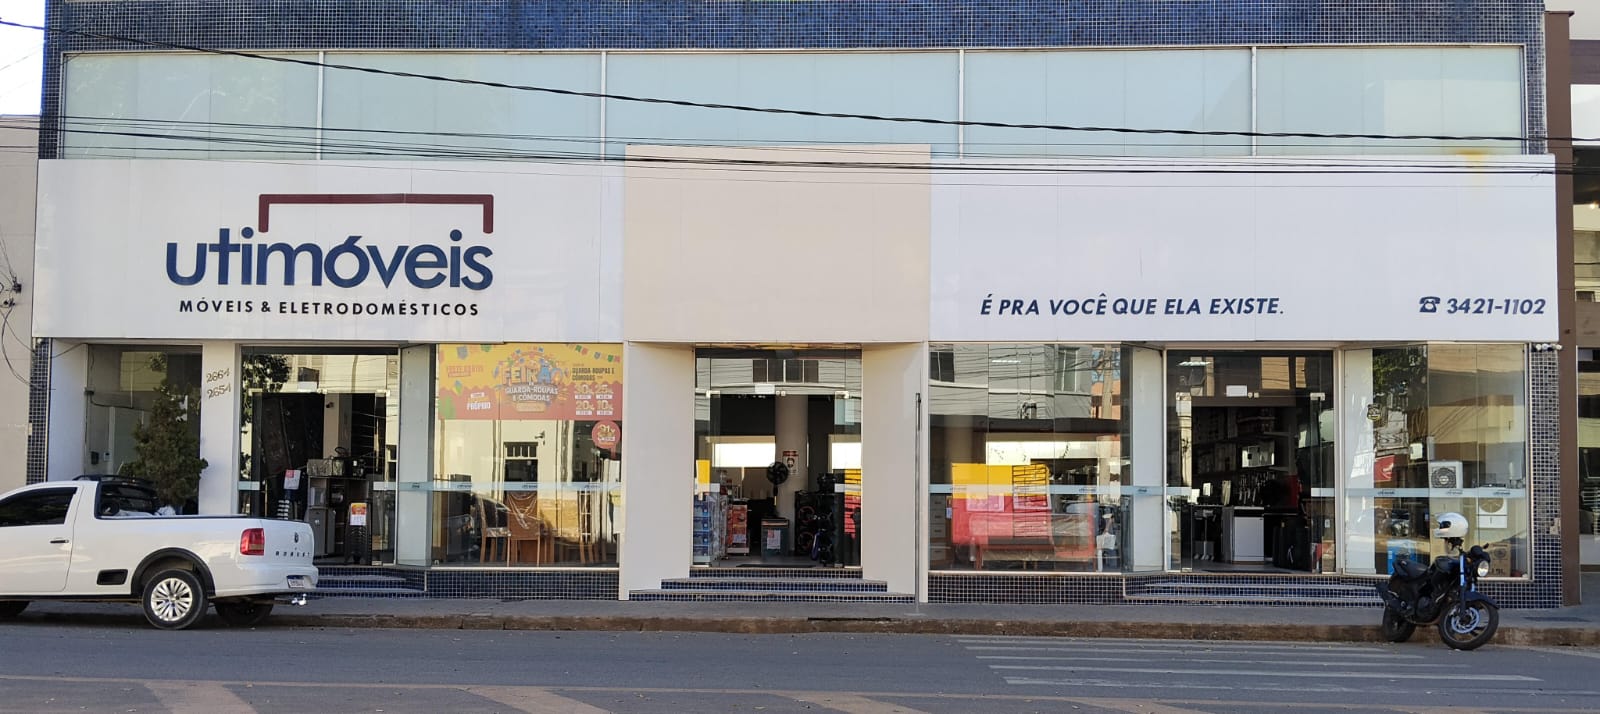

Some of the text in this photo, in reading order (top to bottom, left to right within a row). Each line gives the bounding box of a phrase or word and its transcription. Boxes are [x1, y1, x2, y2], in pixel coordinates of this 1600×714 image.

[166, 227, 493, 291] utimóveis
[179, 297, 479, 317] MÓVEIS & ELETRODOMÉSTICOS
[980, 293, 1284, 316] É PRA VOCÊ QUE ELA EXISTE.
[1447, 298, 1546, 315] 3421-1102
